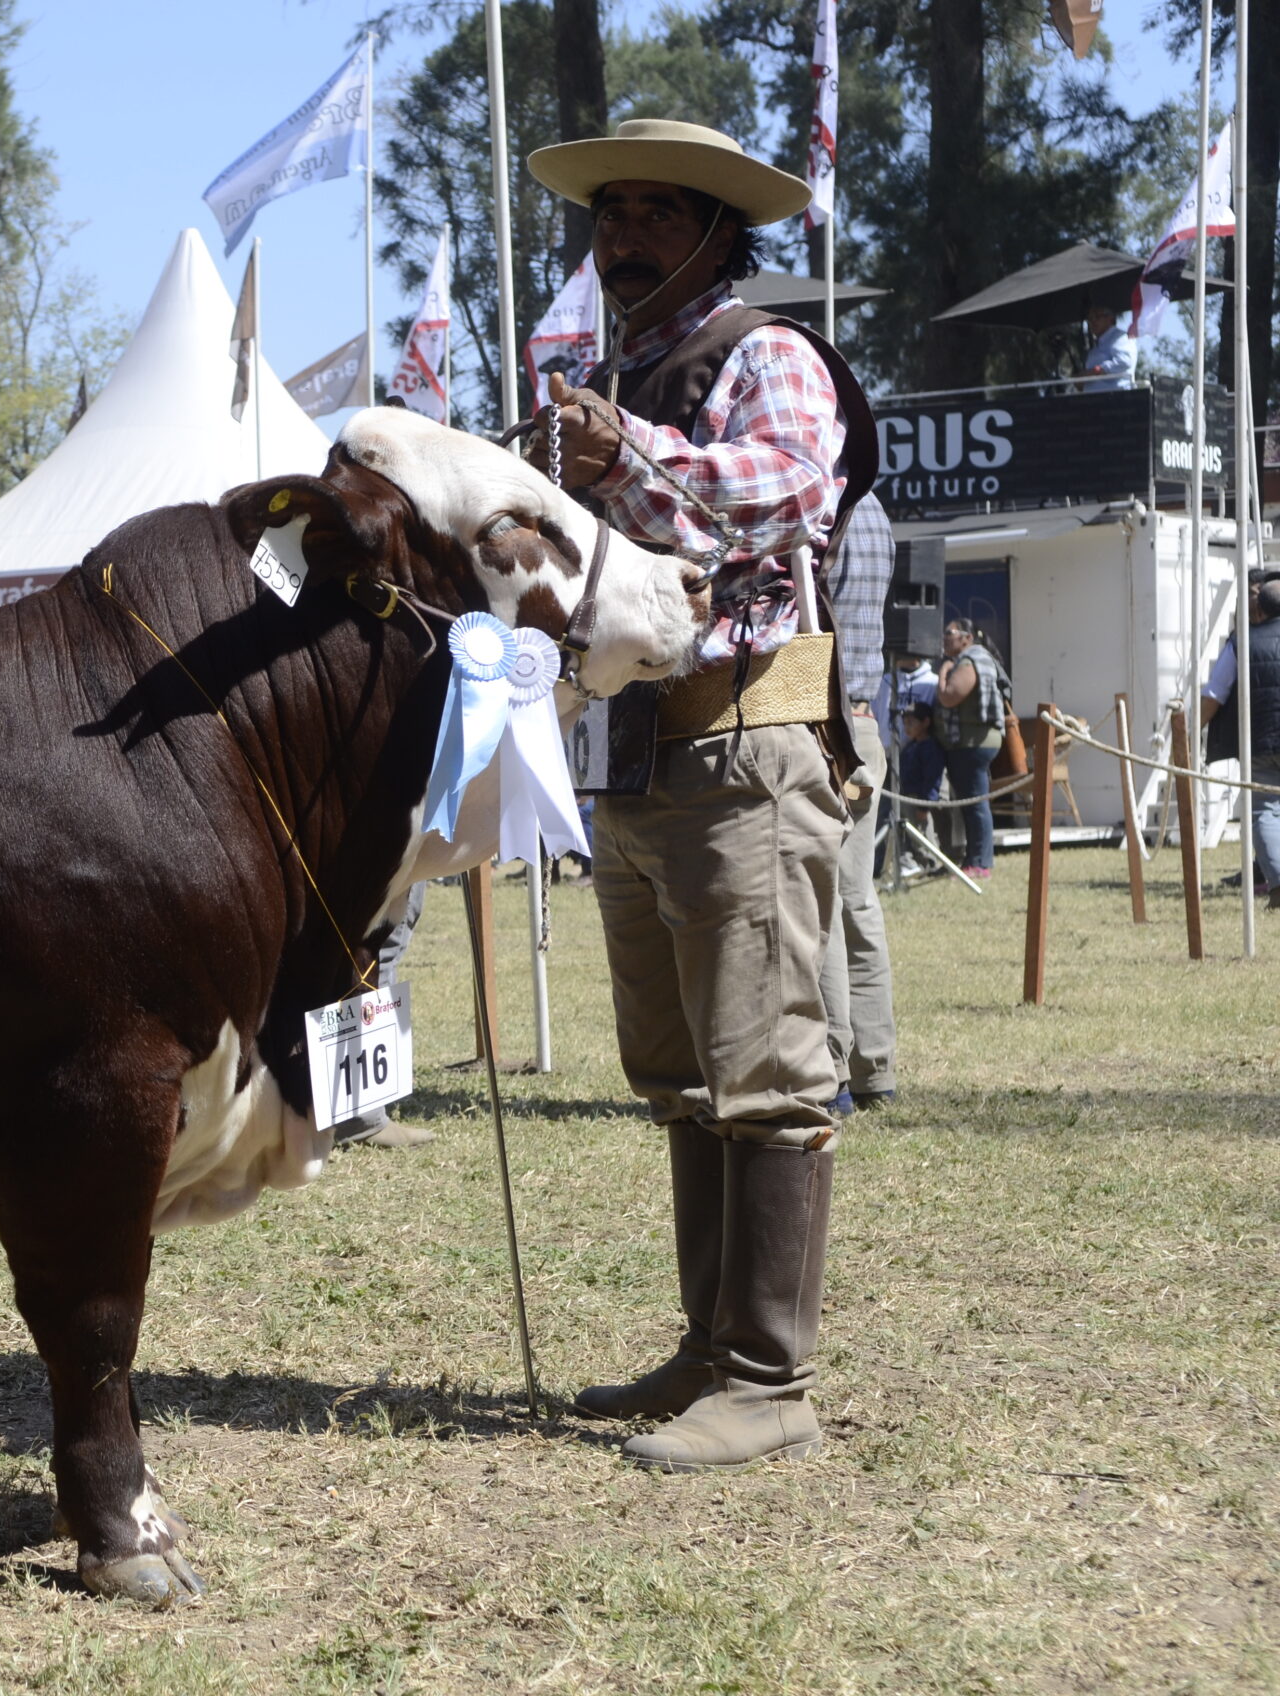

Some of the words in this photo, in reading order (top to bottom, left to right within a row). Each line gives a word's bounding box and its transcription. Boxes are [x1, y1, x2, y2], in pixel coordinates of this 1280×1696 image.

[891, 474, 1000, 500] futuro
[253, 542, 302, 605] 7559
[376, 997, 402, 1014] Braford
[339, 1043, 388, 1096] 116
